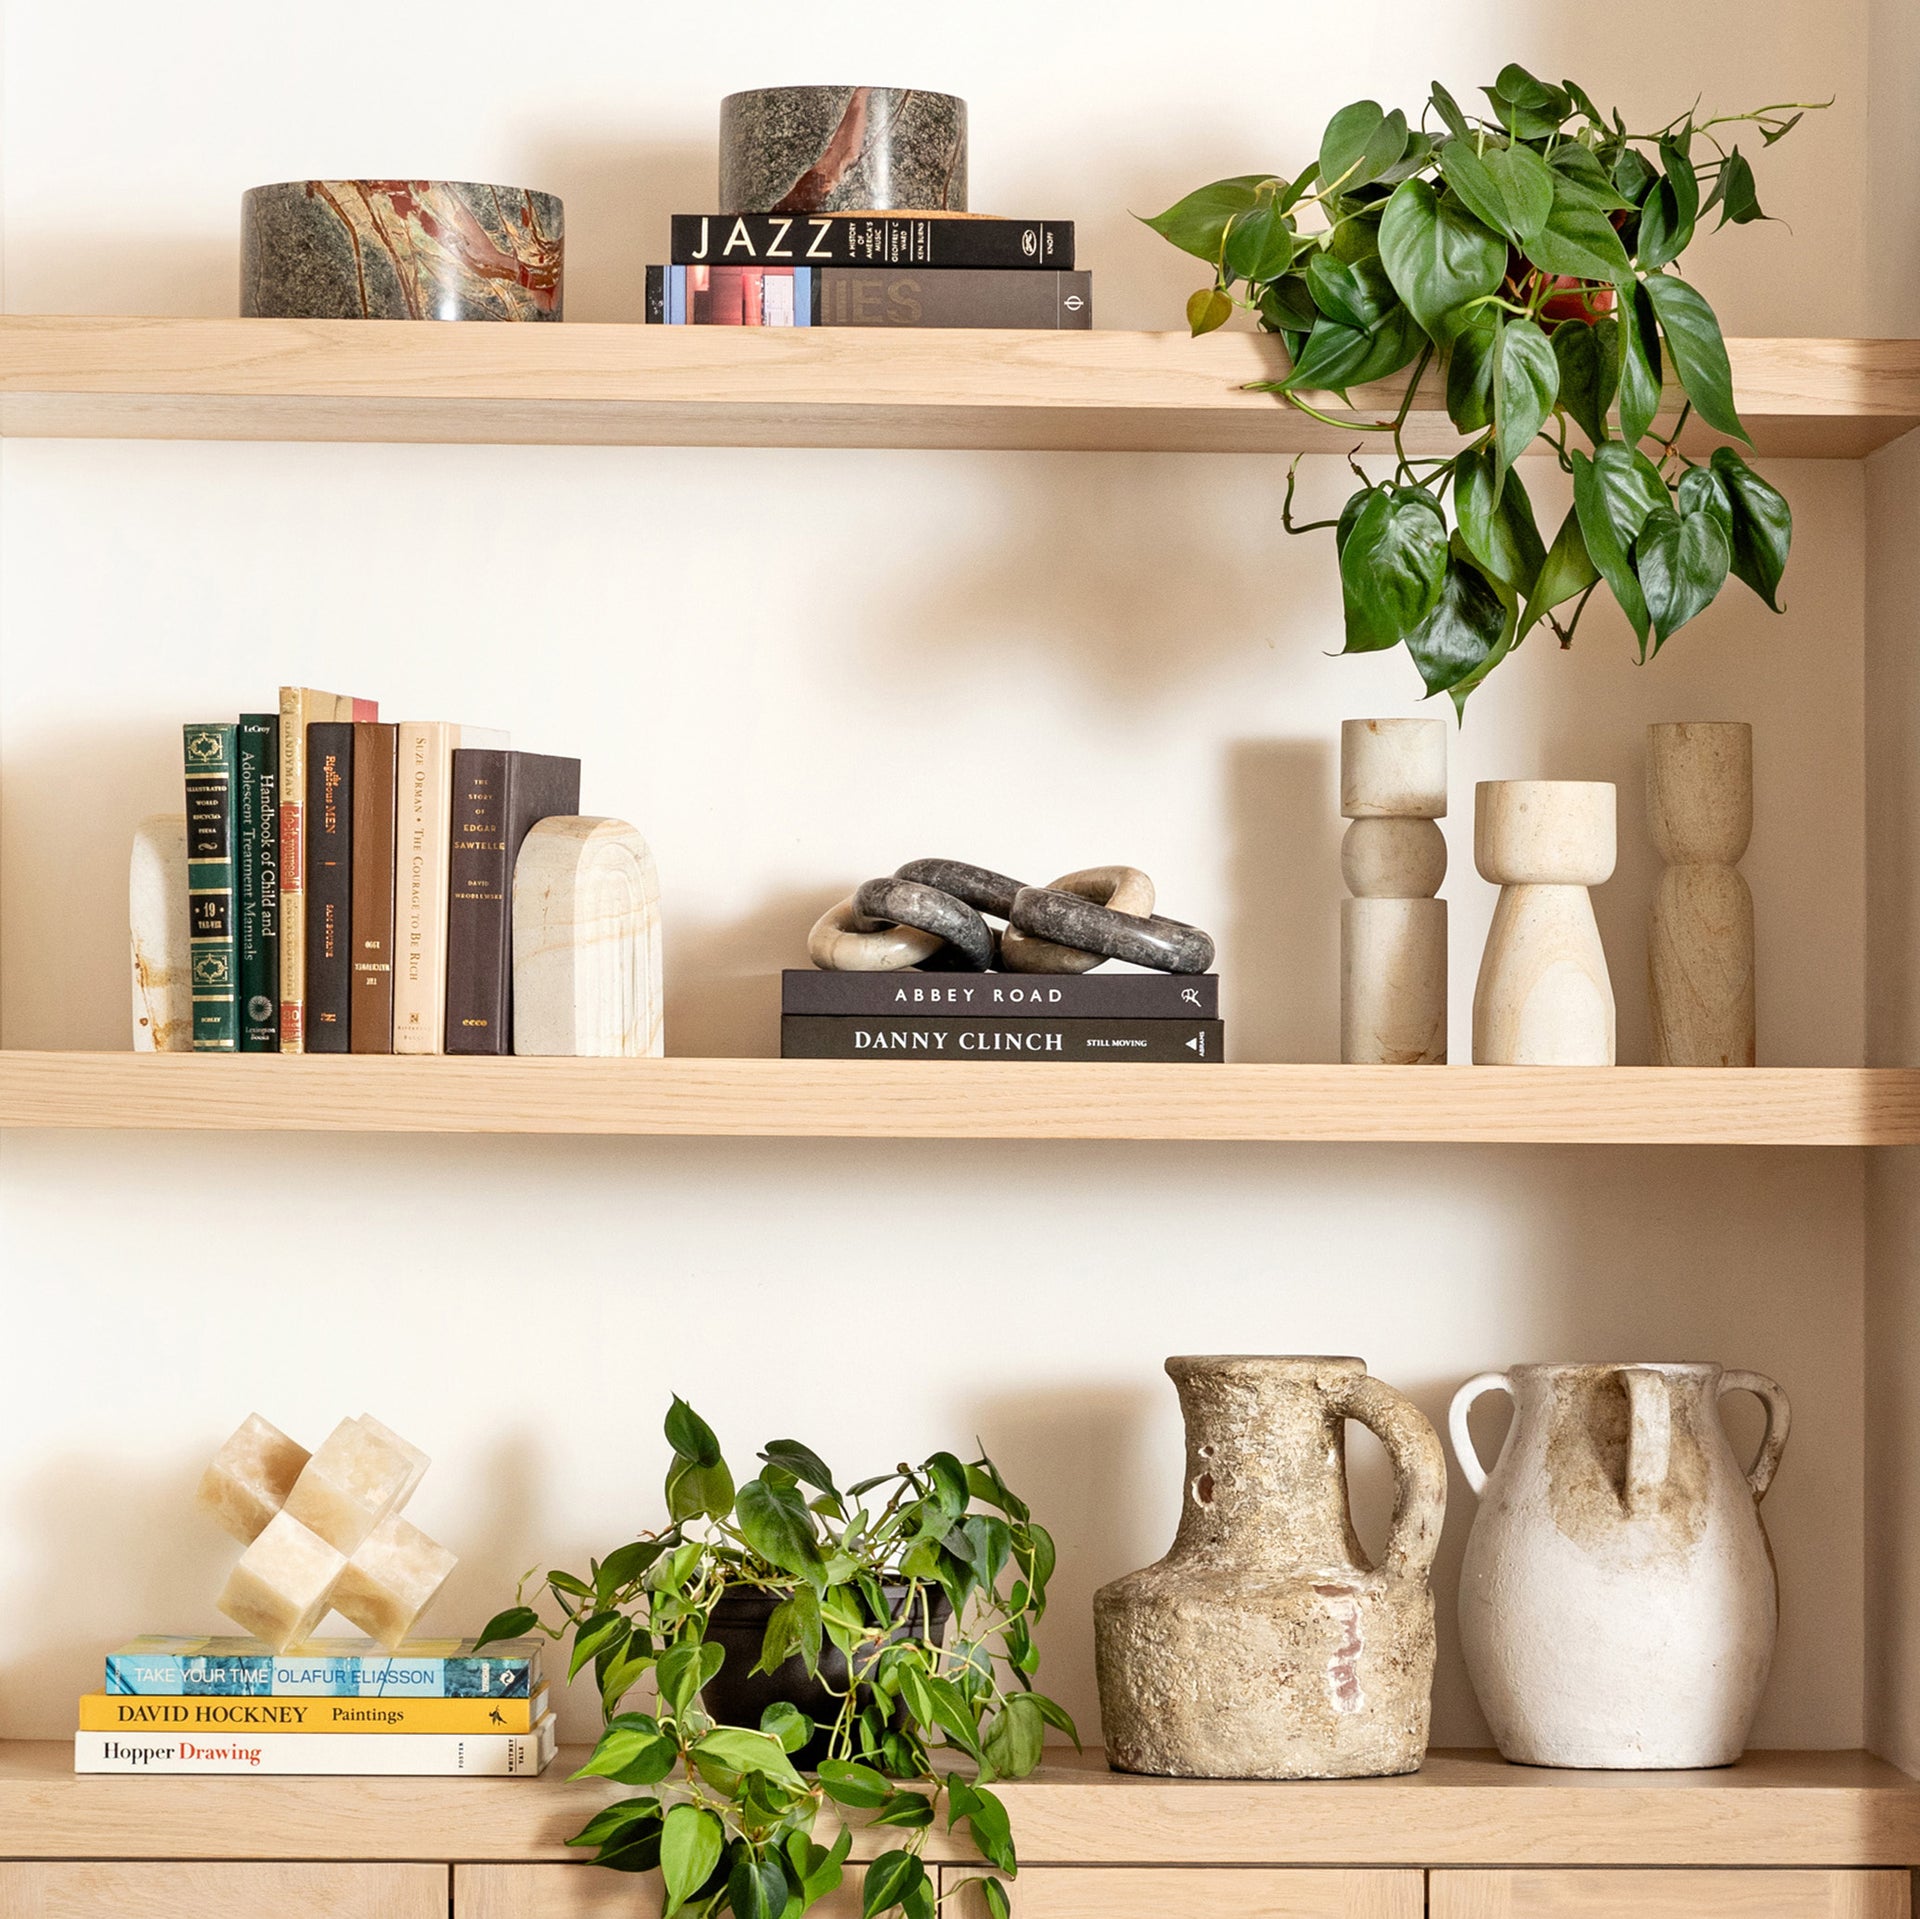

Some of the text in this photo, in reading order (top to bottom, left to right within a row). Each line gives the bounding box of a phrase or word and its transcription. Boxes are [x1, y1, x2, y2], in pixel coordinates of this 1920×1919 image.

[691, 217, 834, 259] JAZZ
[848, 222, 857, 251] HISTORY
[857, 235, 865, 245] OF
[865, 221, 874, 260] AMERICA'S
[874, 229, 882, 252] MUSIC
[891, 229, 899, 263] GEOFFREY
[900, 230, 908, 251] WARD
[917, 222, 925, 260] KEN BURNS
[243, 724, 271, 735] LeCroy
[323, 755, 336, 834] Righteous MEN
[463, 824, 497, 832] EDGAR
[242, 750, 257, 961] Adolescent Treatment Manuals
[260, 774, 276, 937] Handbook of Child and
[454, 841, 506, 850] SAWTELLE
[203, 902, 216, 918] 19
[894, 987, 1063, 1003] ABBEY ROAD
[462, 1019, 488, 1027] ecco
[250, 1033, 270, 1041] Books
[854, 1030, 1148, 1052] DANNY CLINCH STILL MOVING
[1198, 1031, 1206, 1057] ABRAMS
[134, 1667, 176, 1683] TAKE
[180, 1667, 227, 1683] YOUR
[235, 1667, 269, 1683] TIME
[277, 1668, 347, 1684] OLAFUR
[352, 1669, 435, 1685] ELIASSON
[118, 1705, 404, 1725] DAVID HOCKNEY Paintings
[103, 1742, 262, 1766] Hopper Drawing
[457, 1742, 465, 1769] FOSTER
